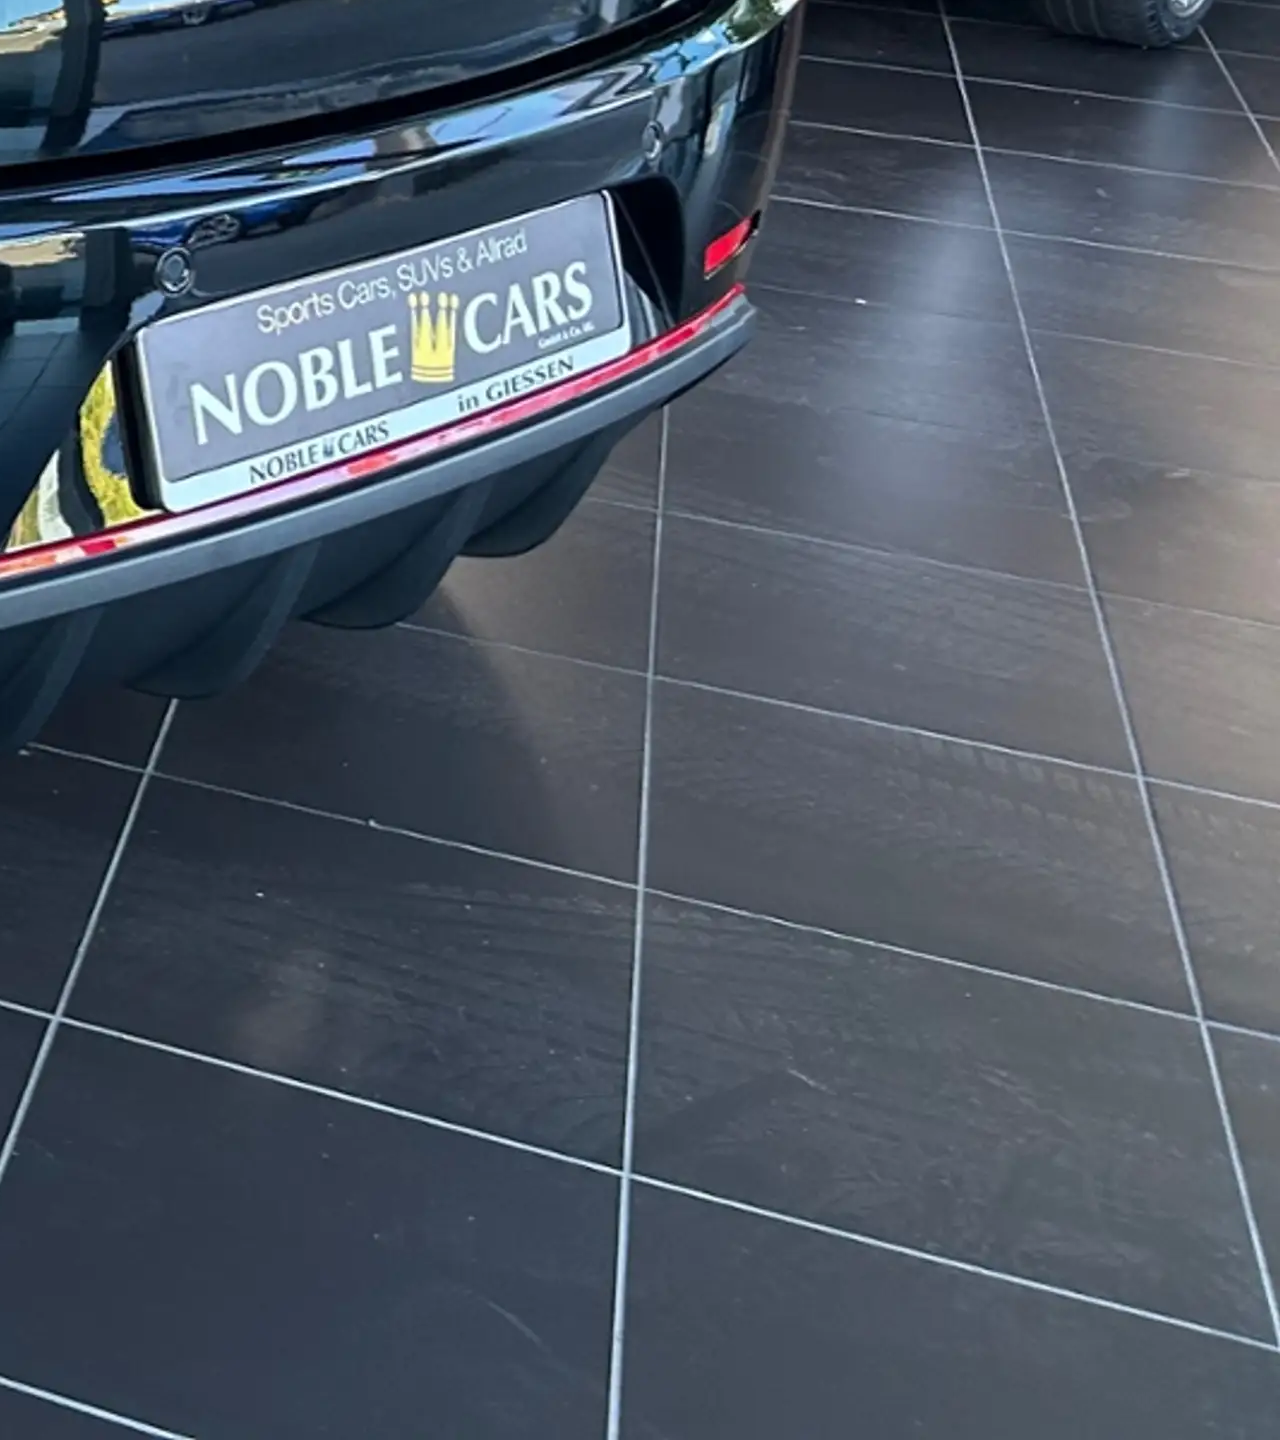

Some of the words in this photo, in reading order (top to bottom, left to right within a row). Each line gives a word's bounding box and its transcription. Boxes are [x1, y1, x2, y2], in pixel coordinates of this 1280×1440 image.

[256, 291, 335, 336] Sports
[337, 275, 396, 310] Cars,
[396, 254, 454, 292] SUVs
[456, 246, 474, 274] &
[476, 228, 528, 267] Allrad
[189, 324, 404, 446] NOBLE
[463, 260, 593, 354] CARS
[248, 444, 320, 485] NOBLE
[338, 419, 390, 455] CARS
[456, 393, 481, 413] in
[485, 355, 575, 403] GIESSEN
